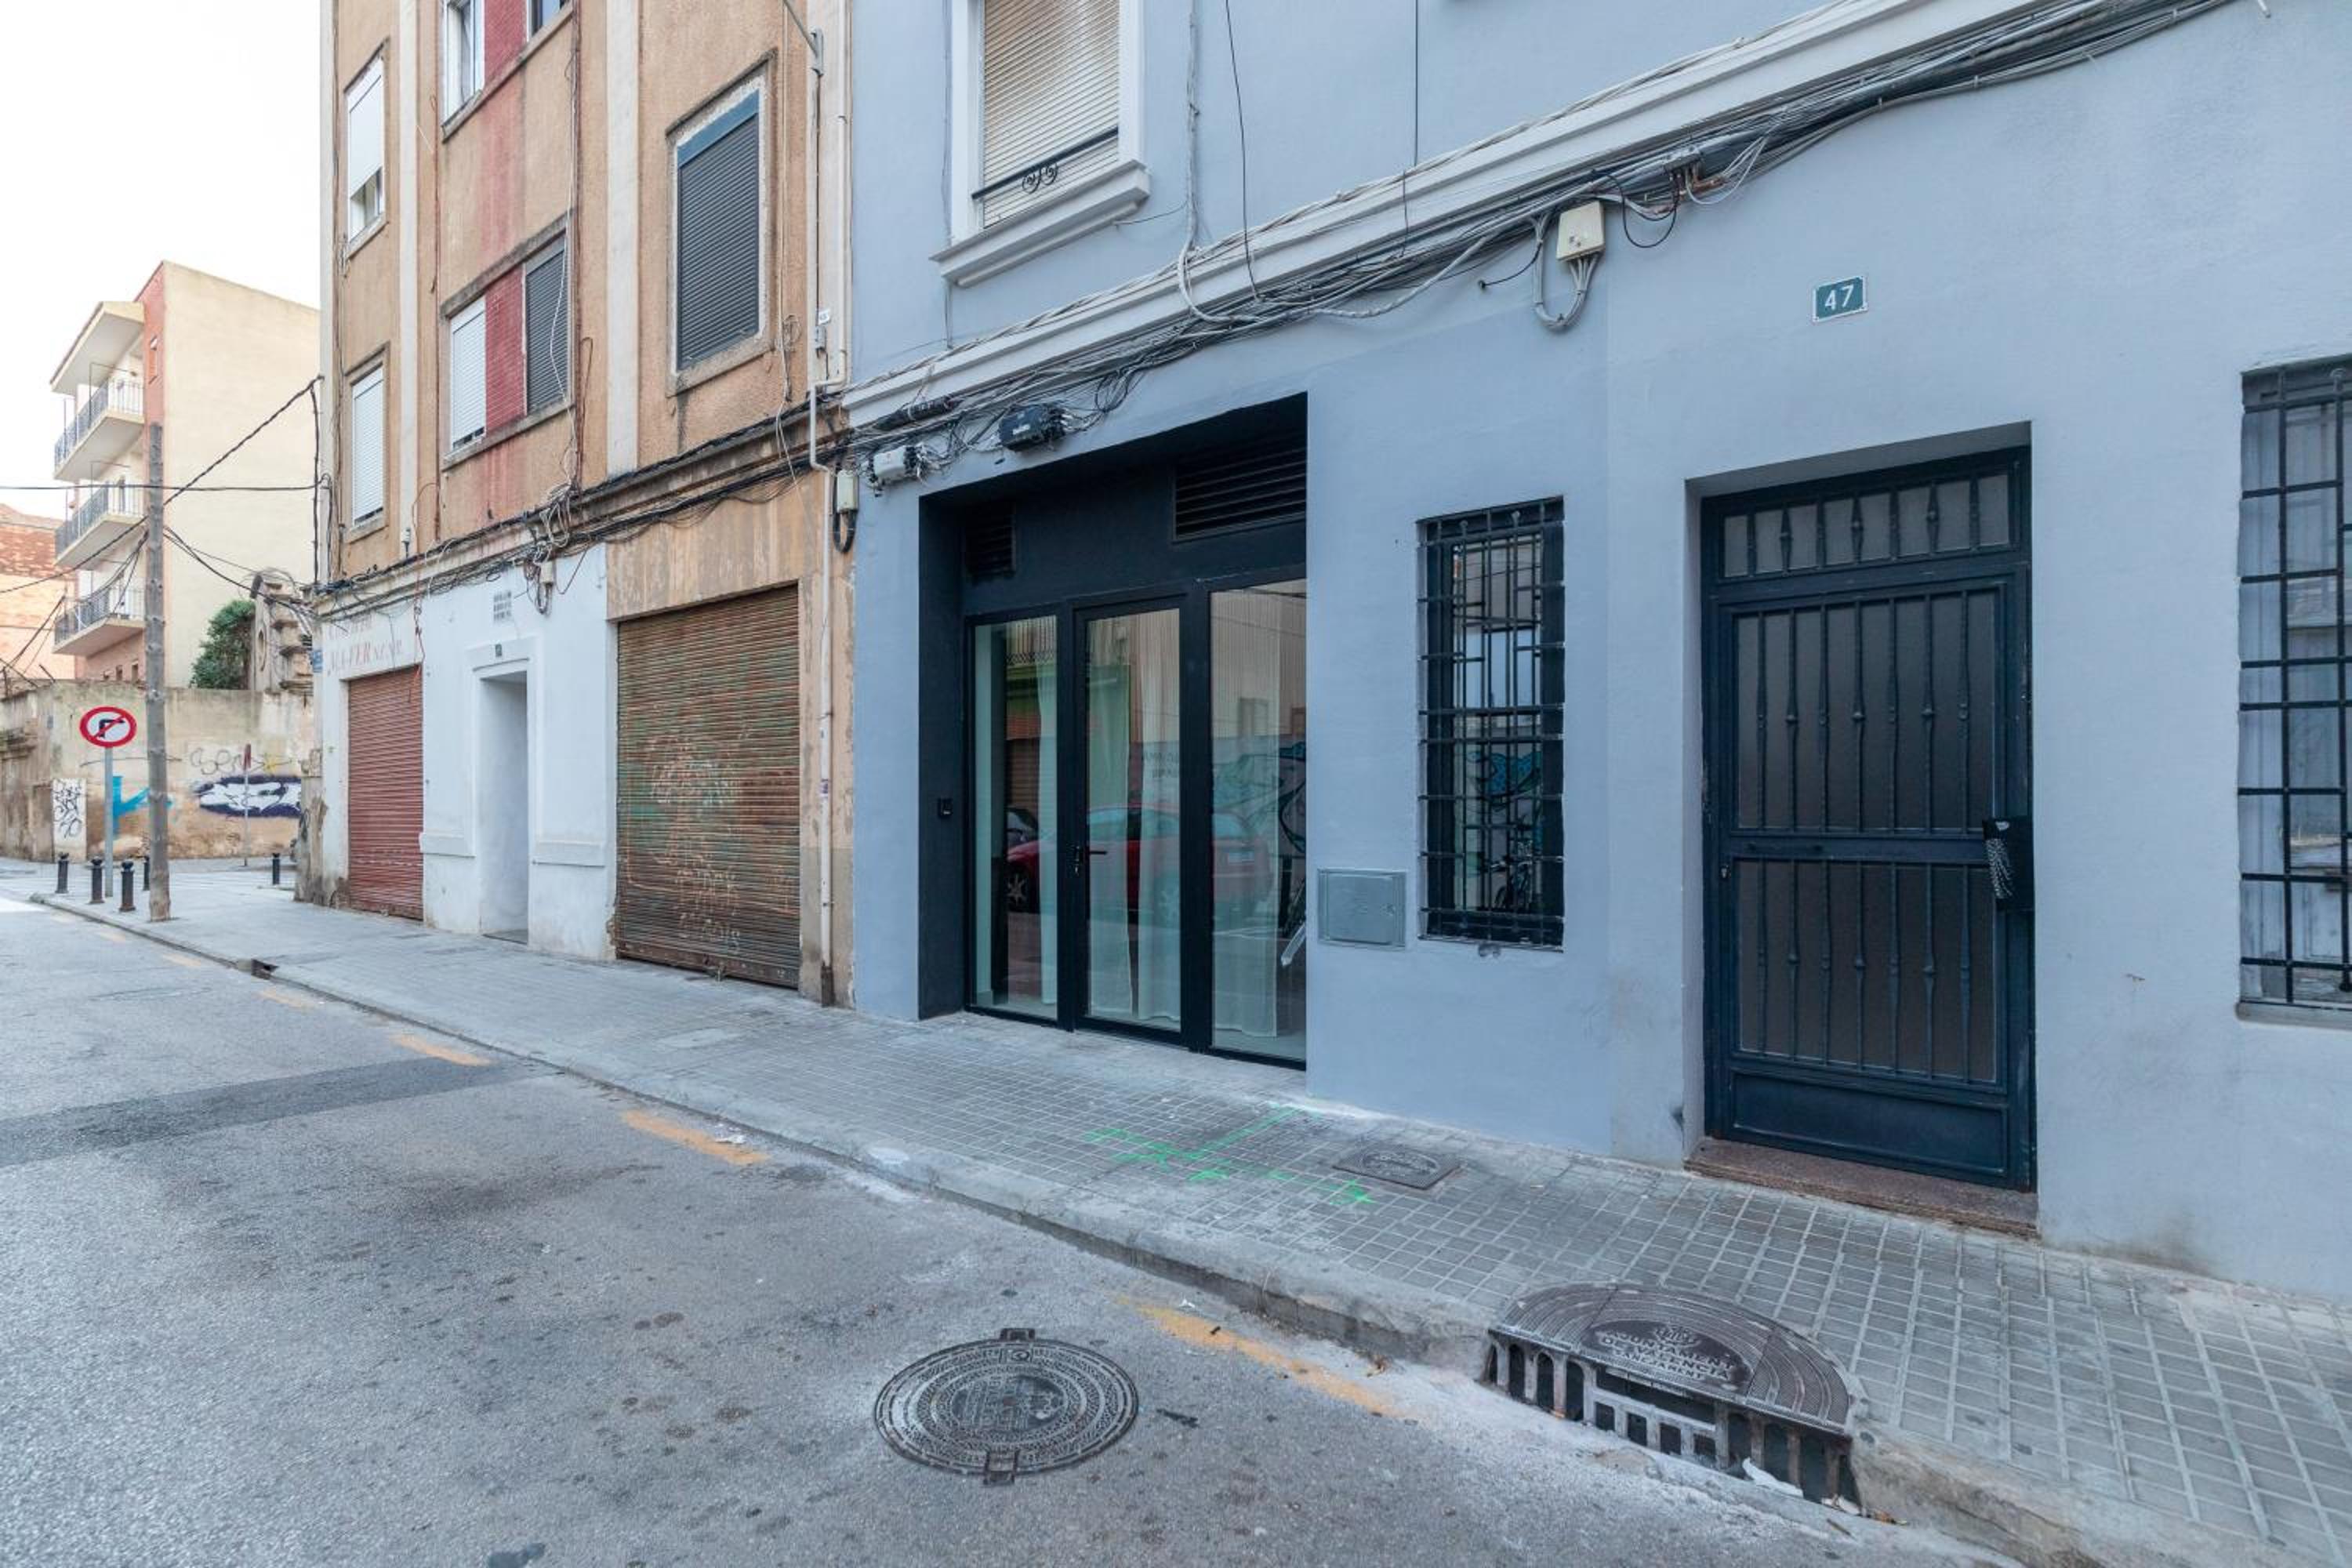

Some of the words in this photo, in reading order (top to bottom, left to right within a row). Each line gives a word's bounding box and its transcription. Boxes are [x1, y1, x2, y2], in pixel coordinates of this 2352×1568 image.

[1825, 285, 1854, 310] 47
[1601, 1336, 1625, 1351] DE
[1636, 1345, 1730, 1380] VALENCIA
[1605, 1330, 1733, 1369] AJUNTAMENT
